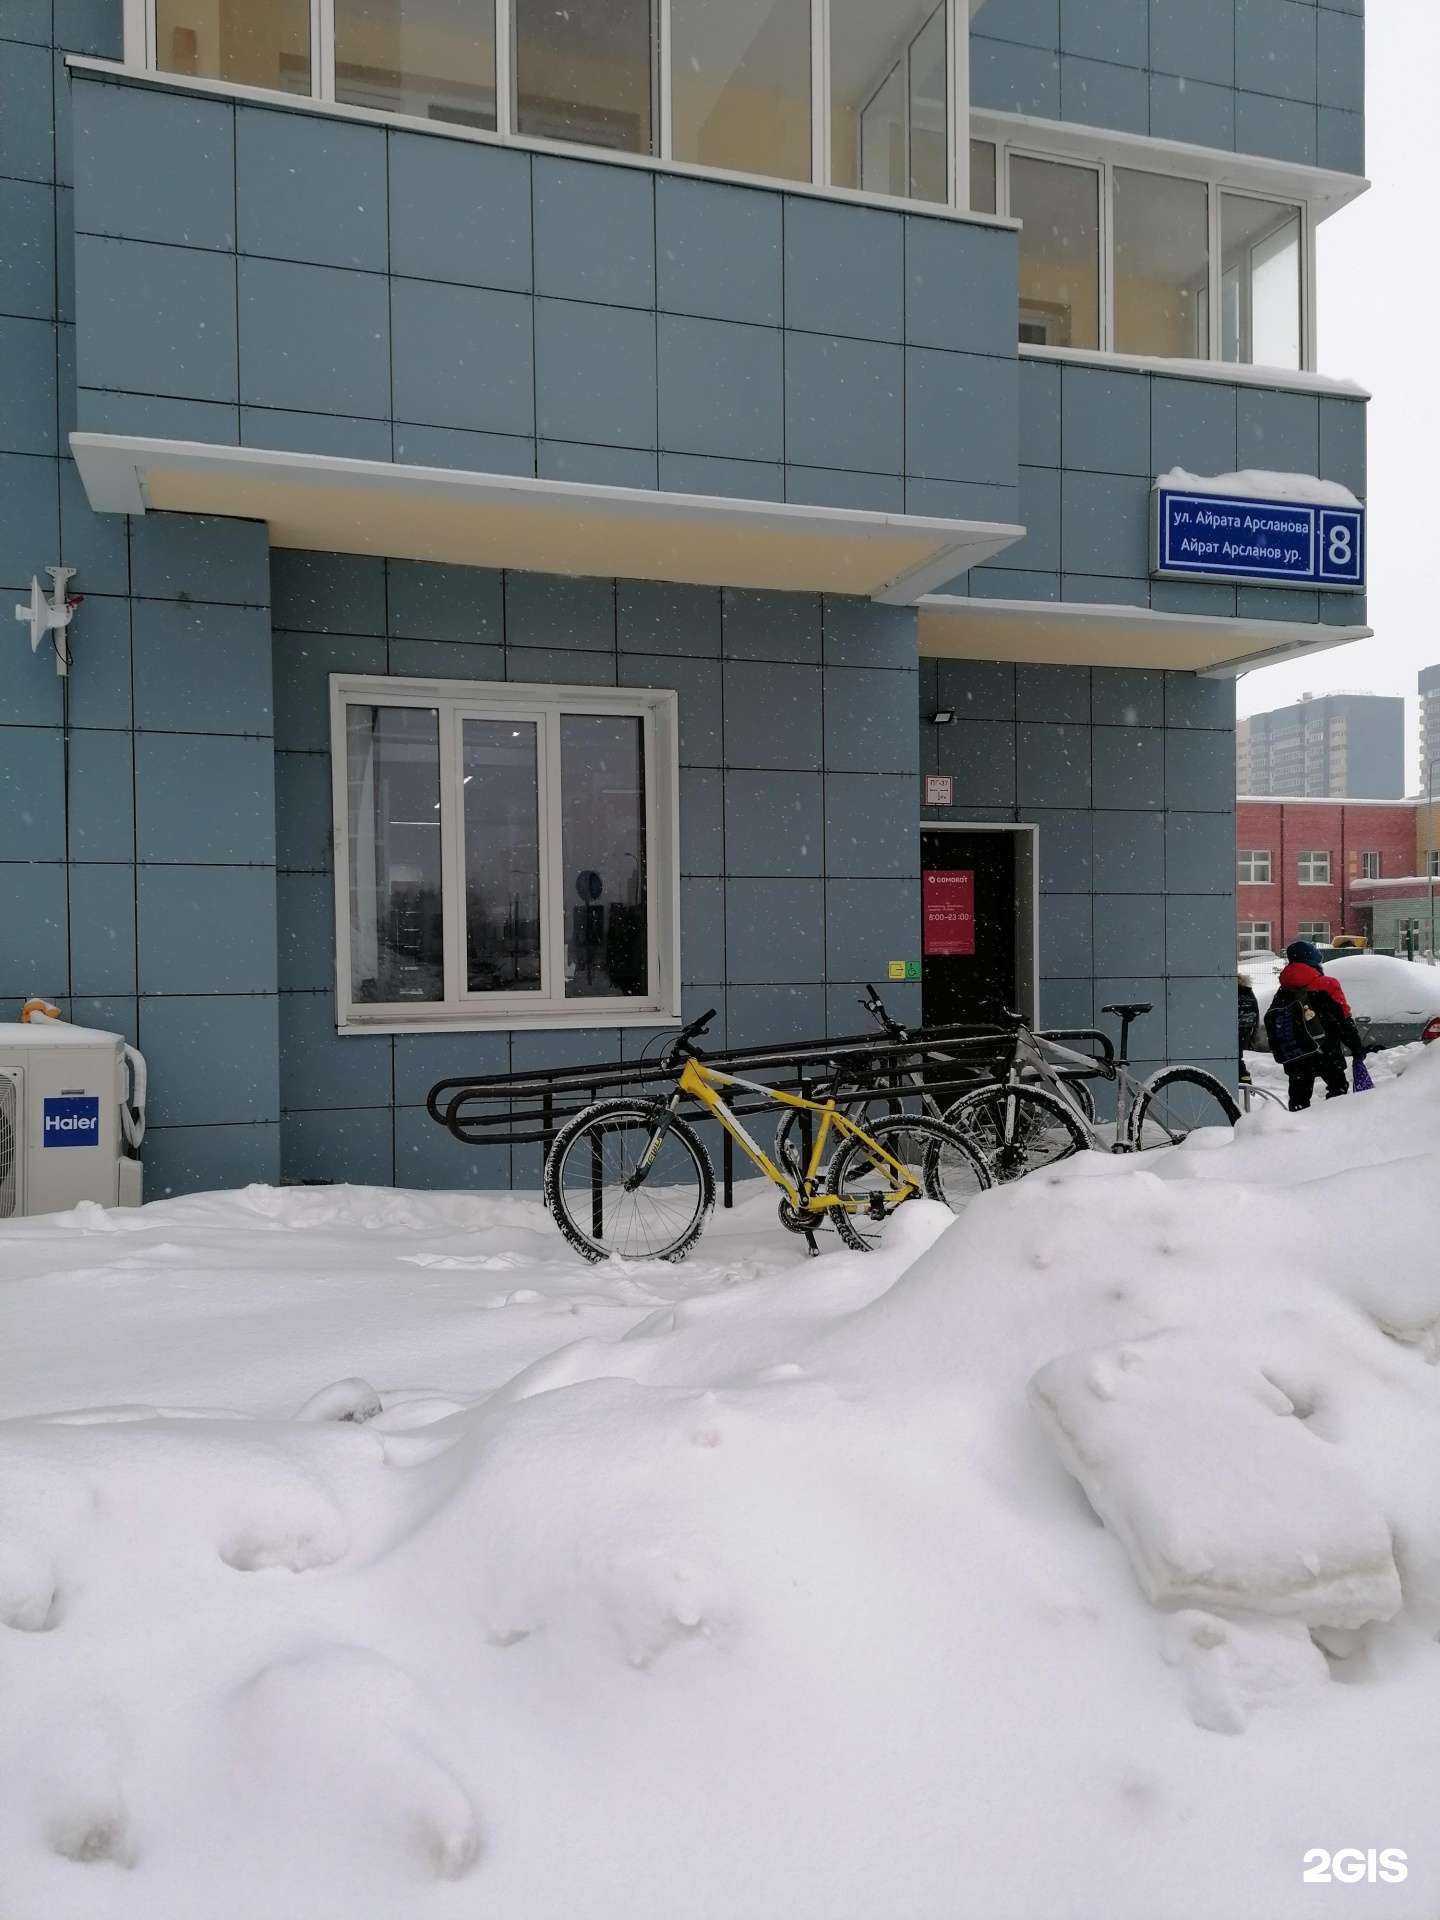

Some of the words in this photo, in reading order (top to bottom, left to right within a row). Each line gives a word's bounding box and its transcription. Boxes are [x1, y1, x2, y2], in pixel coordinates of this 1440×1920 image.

[1173, 511, 1192, 526] ул.
[1196, 510, 1241, 530] Айрата
[1243, 515, 1309, 534] Арсланова
[1181, 537, 1219, 556] Айрат
[1222, 541, 1281, 559] Арсланов
[1283, 548, 1302, 564] ур.
[1328, 524, 1352, 565] 8
[45, 1114, 97, 1131] Haier
